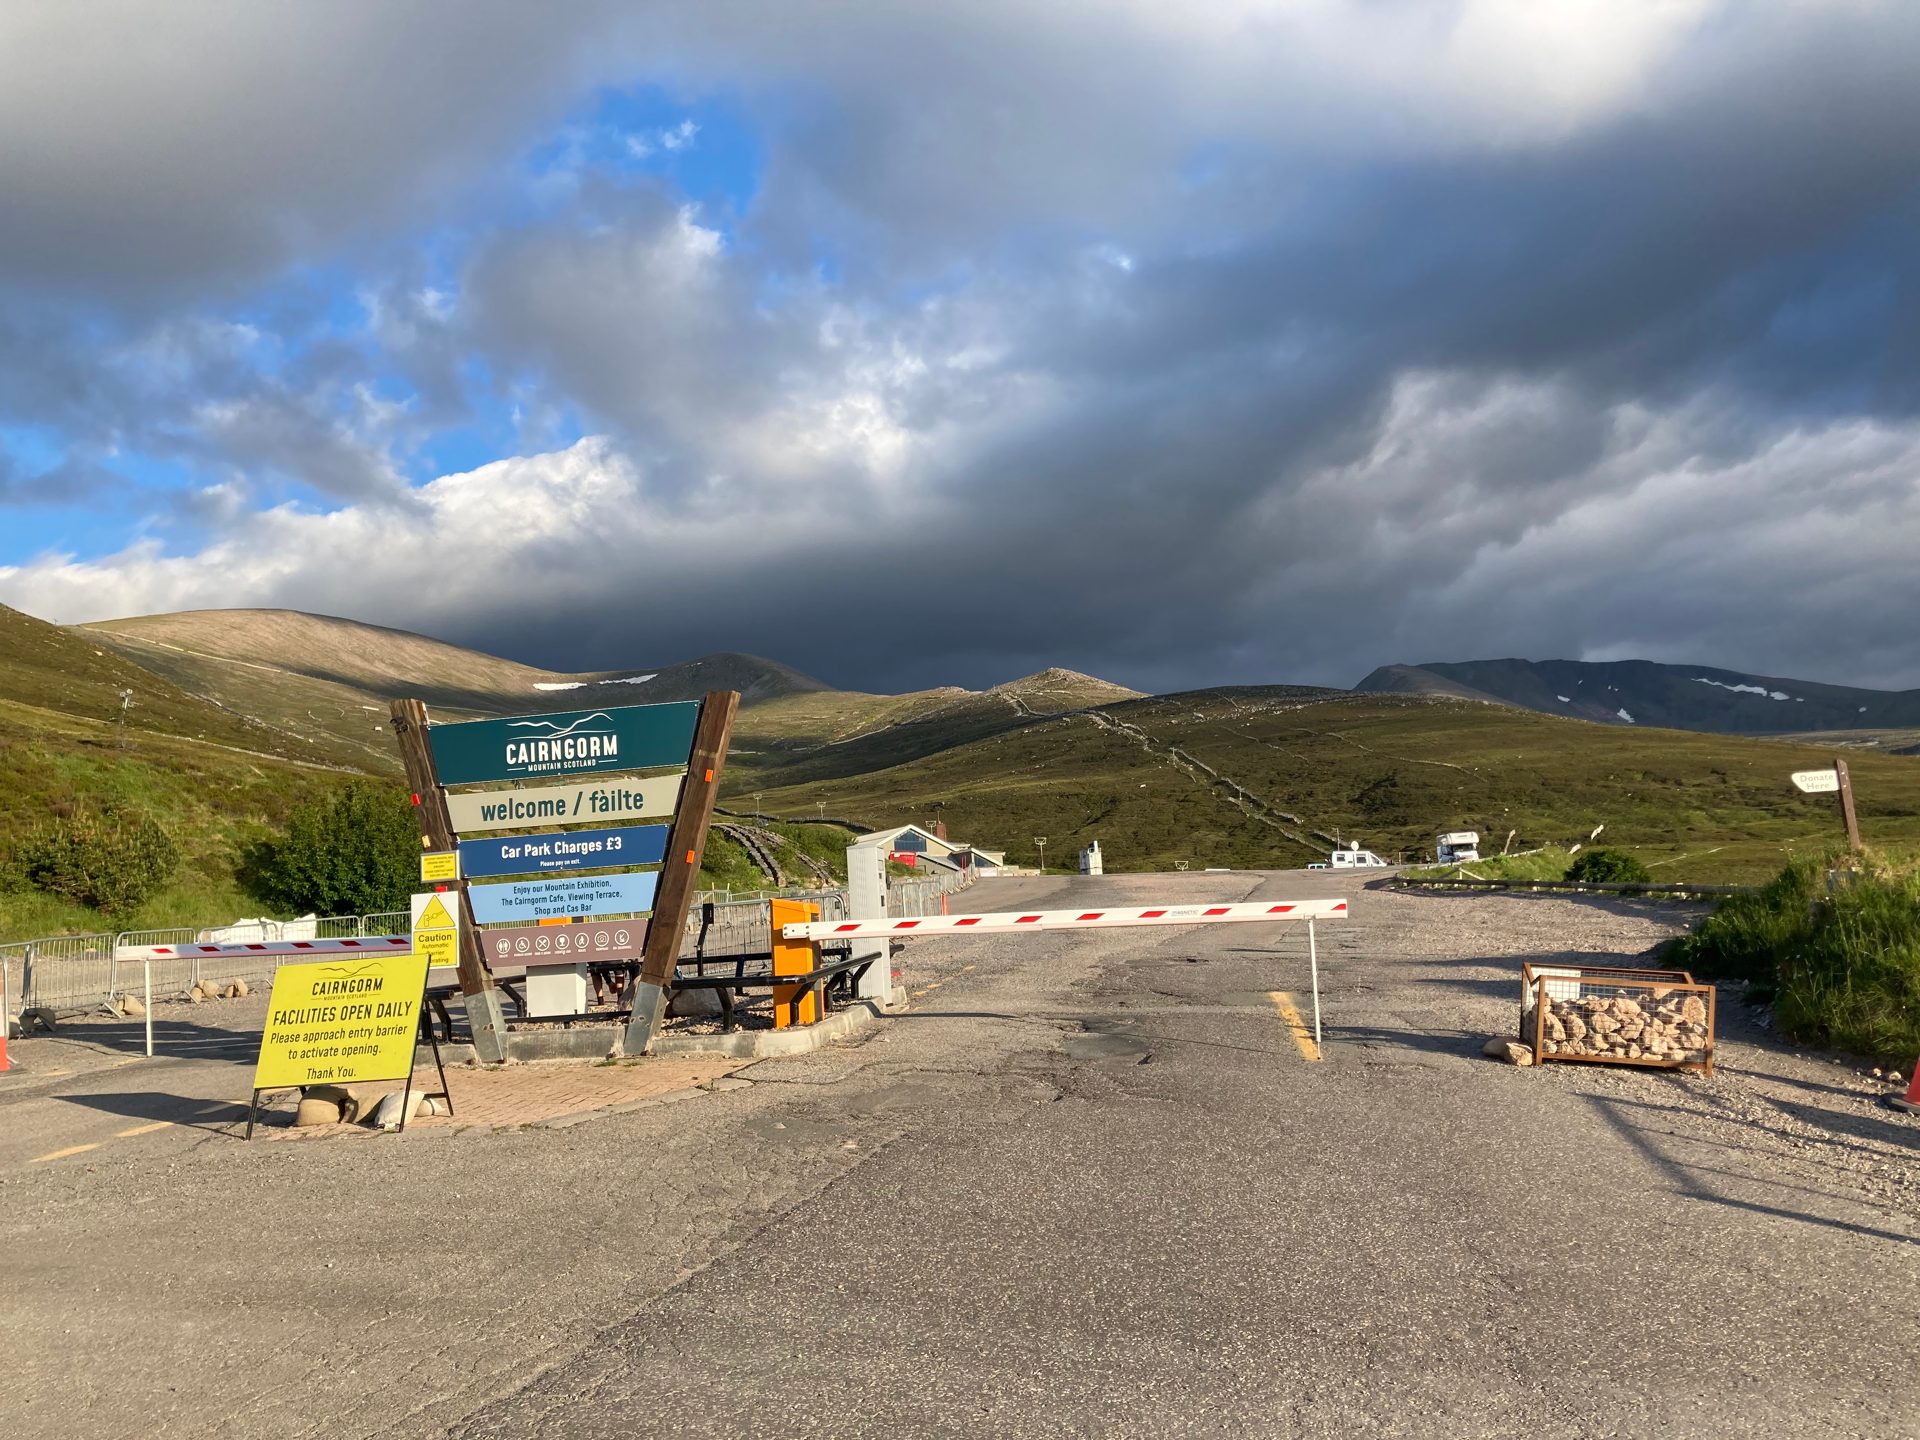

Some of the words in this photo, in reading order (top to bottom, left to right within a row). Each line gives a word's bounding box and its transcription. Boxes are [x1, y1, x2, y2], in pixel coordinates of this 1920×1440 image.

[506, 734, 618, 765] CAIRNGORM
[528, 762, 561, 772] MOUNTAIN
[563, 759, 596, 769] SCOTLAND
[1800, 774, 1834, 782] Donate
[1806, 782, 1830, 790] Here
[481, 798, 566, 821] welcome
[572, 791, 583, 816] /
[589, 789, 644, 813] fàilte
[501, 845, 521, 859] Car
[524, 843, 551, 857] Park
[554, 840, 602, 855] Charges
[606, 836, 622, 850] £3
[513, 886, 531, 895] Enjoy
[532, 885, 543, 893] our
[545, 882, 575, 892] Mountain
[577, 880, 612, 889] Exhibition,
[502, 898, 513, 906] The
[514, 896, 548, 906] Cairngorm
[549, 894, 566, 903] Cafe,
[568, 892, 594, 901] Viewing
[595, 891, 623, 899] Terrace,
[534, 906, 551, 915] Shop
[552, 905, 565, 914] and
[567, 904, 579, 913] Cas
[580, 903, 592, 912] Bar
[418, 933, 452, 942] Caution
[312, 977, 384, 996] CAIRNGORM
[273, 1006, 337, 1026] FACILITIES
[340, 1003, 373, 1021] OPEN
[376, 1001, 413, 1019] DAILY
[270, 1032, 300, 1044] Please
[302, 1028, 345, 1044] approach
[348, 1028, 374, 1040] entry
[376, 1024, 408, 1037] barrier
[288, 1049, 298, 1059] to
[300, 1046, 339, 1059] activate
[341, 1043, 382, 1058] opening.
[307, 1066, 334, 1079] Thank
[338, 1066, 357, 1077] You.
